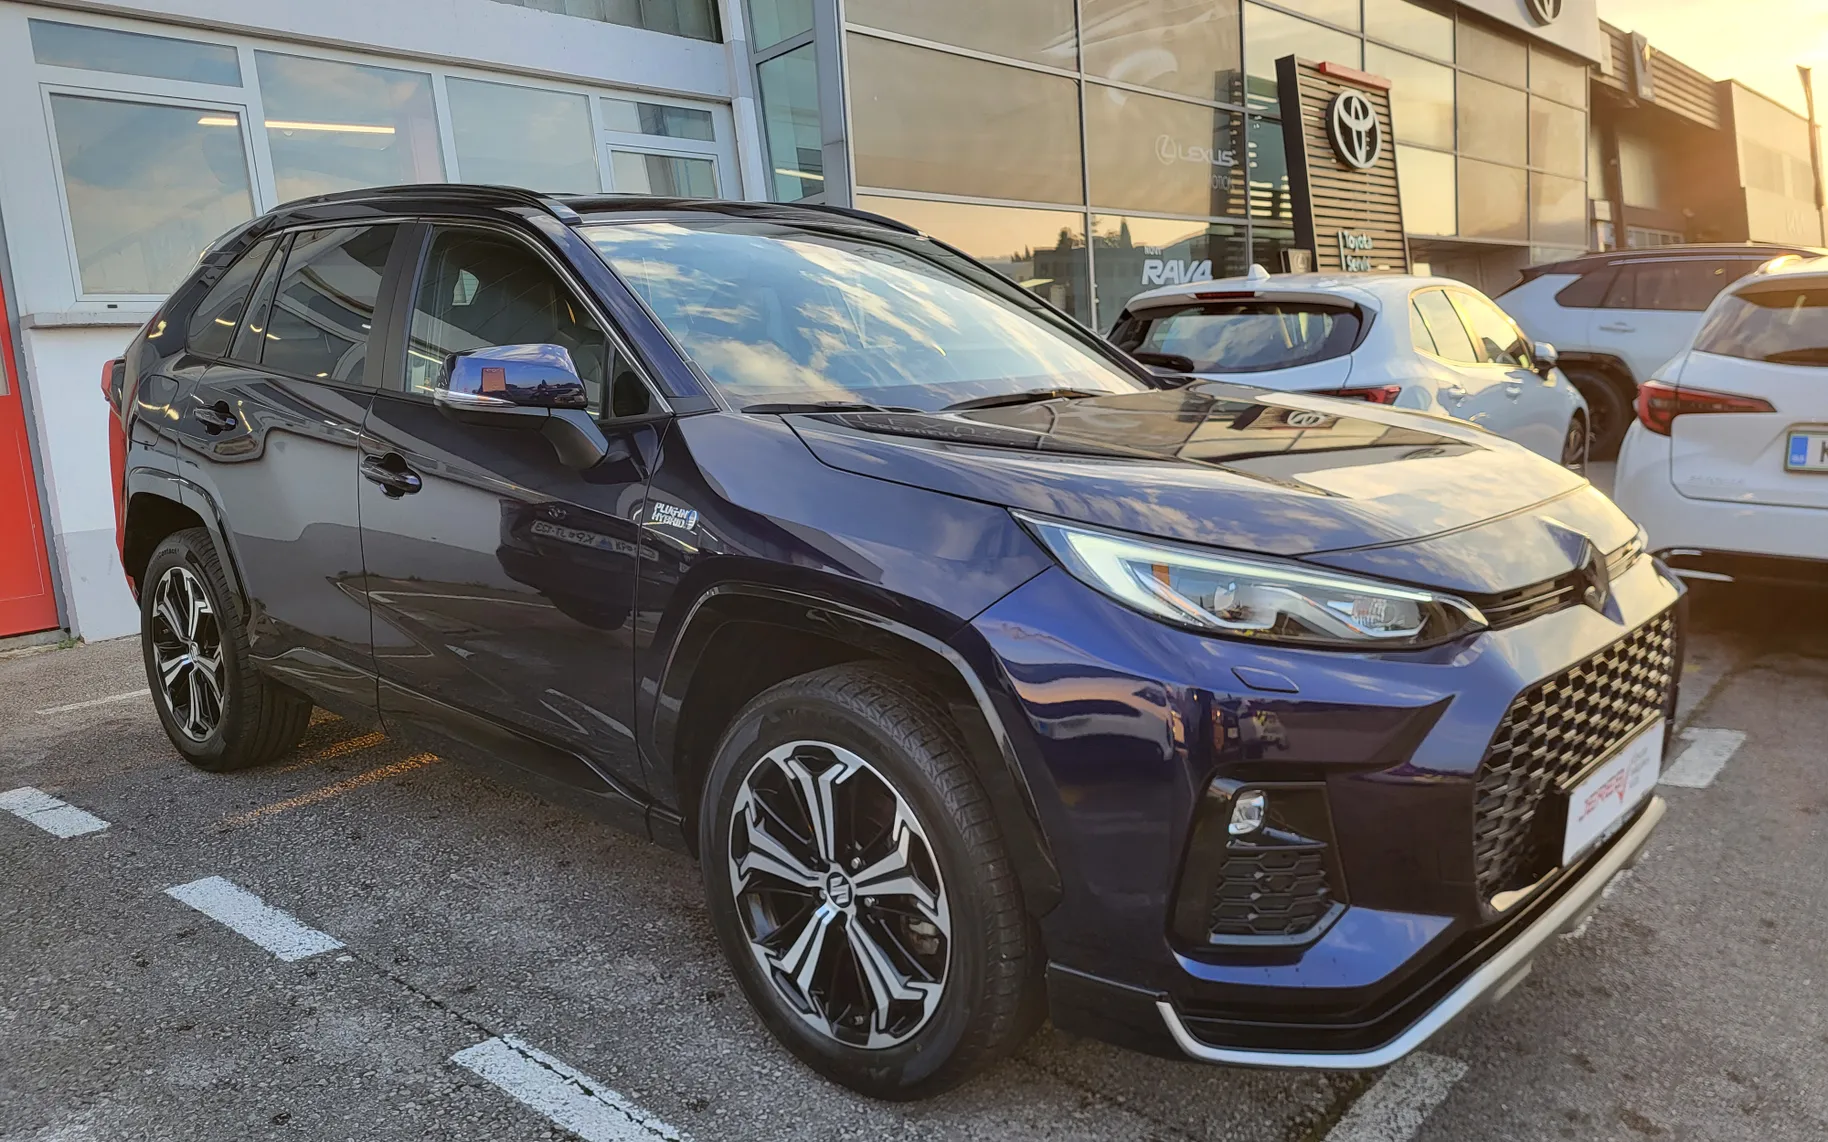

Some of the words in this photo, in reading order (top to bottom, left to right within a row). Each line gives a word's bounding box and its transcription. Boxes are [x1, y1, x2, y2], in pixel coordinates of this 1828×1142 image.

[1178, 144, 1236, 167] LEXUS
[1343, 230, 1372, 252] Toyota
[1142, 259, 1214, 285] RAV4
[651, 511, 685, 528] HYBRID
[654, 502, 688, 519] PLUG-IN
